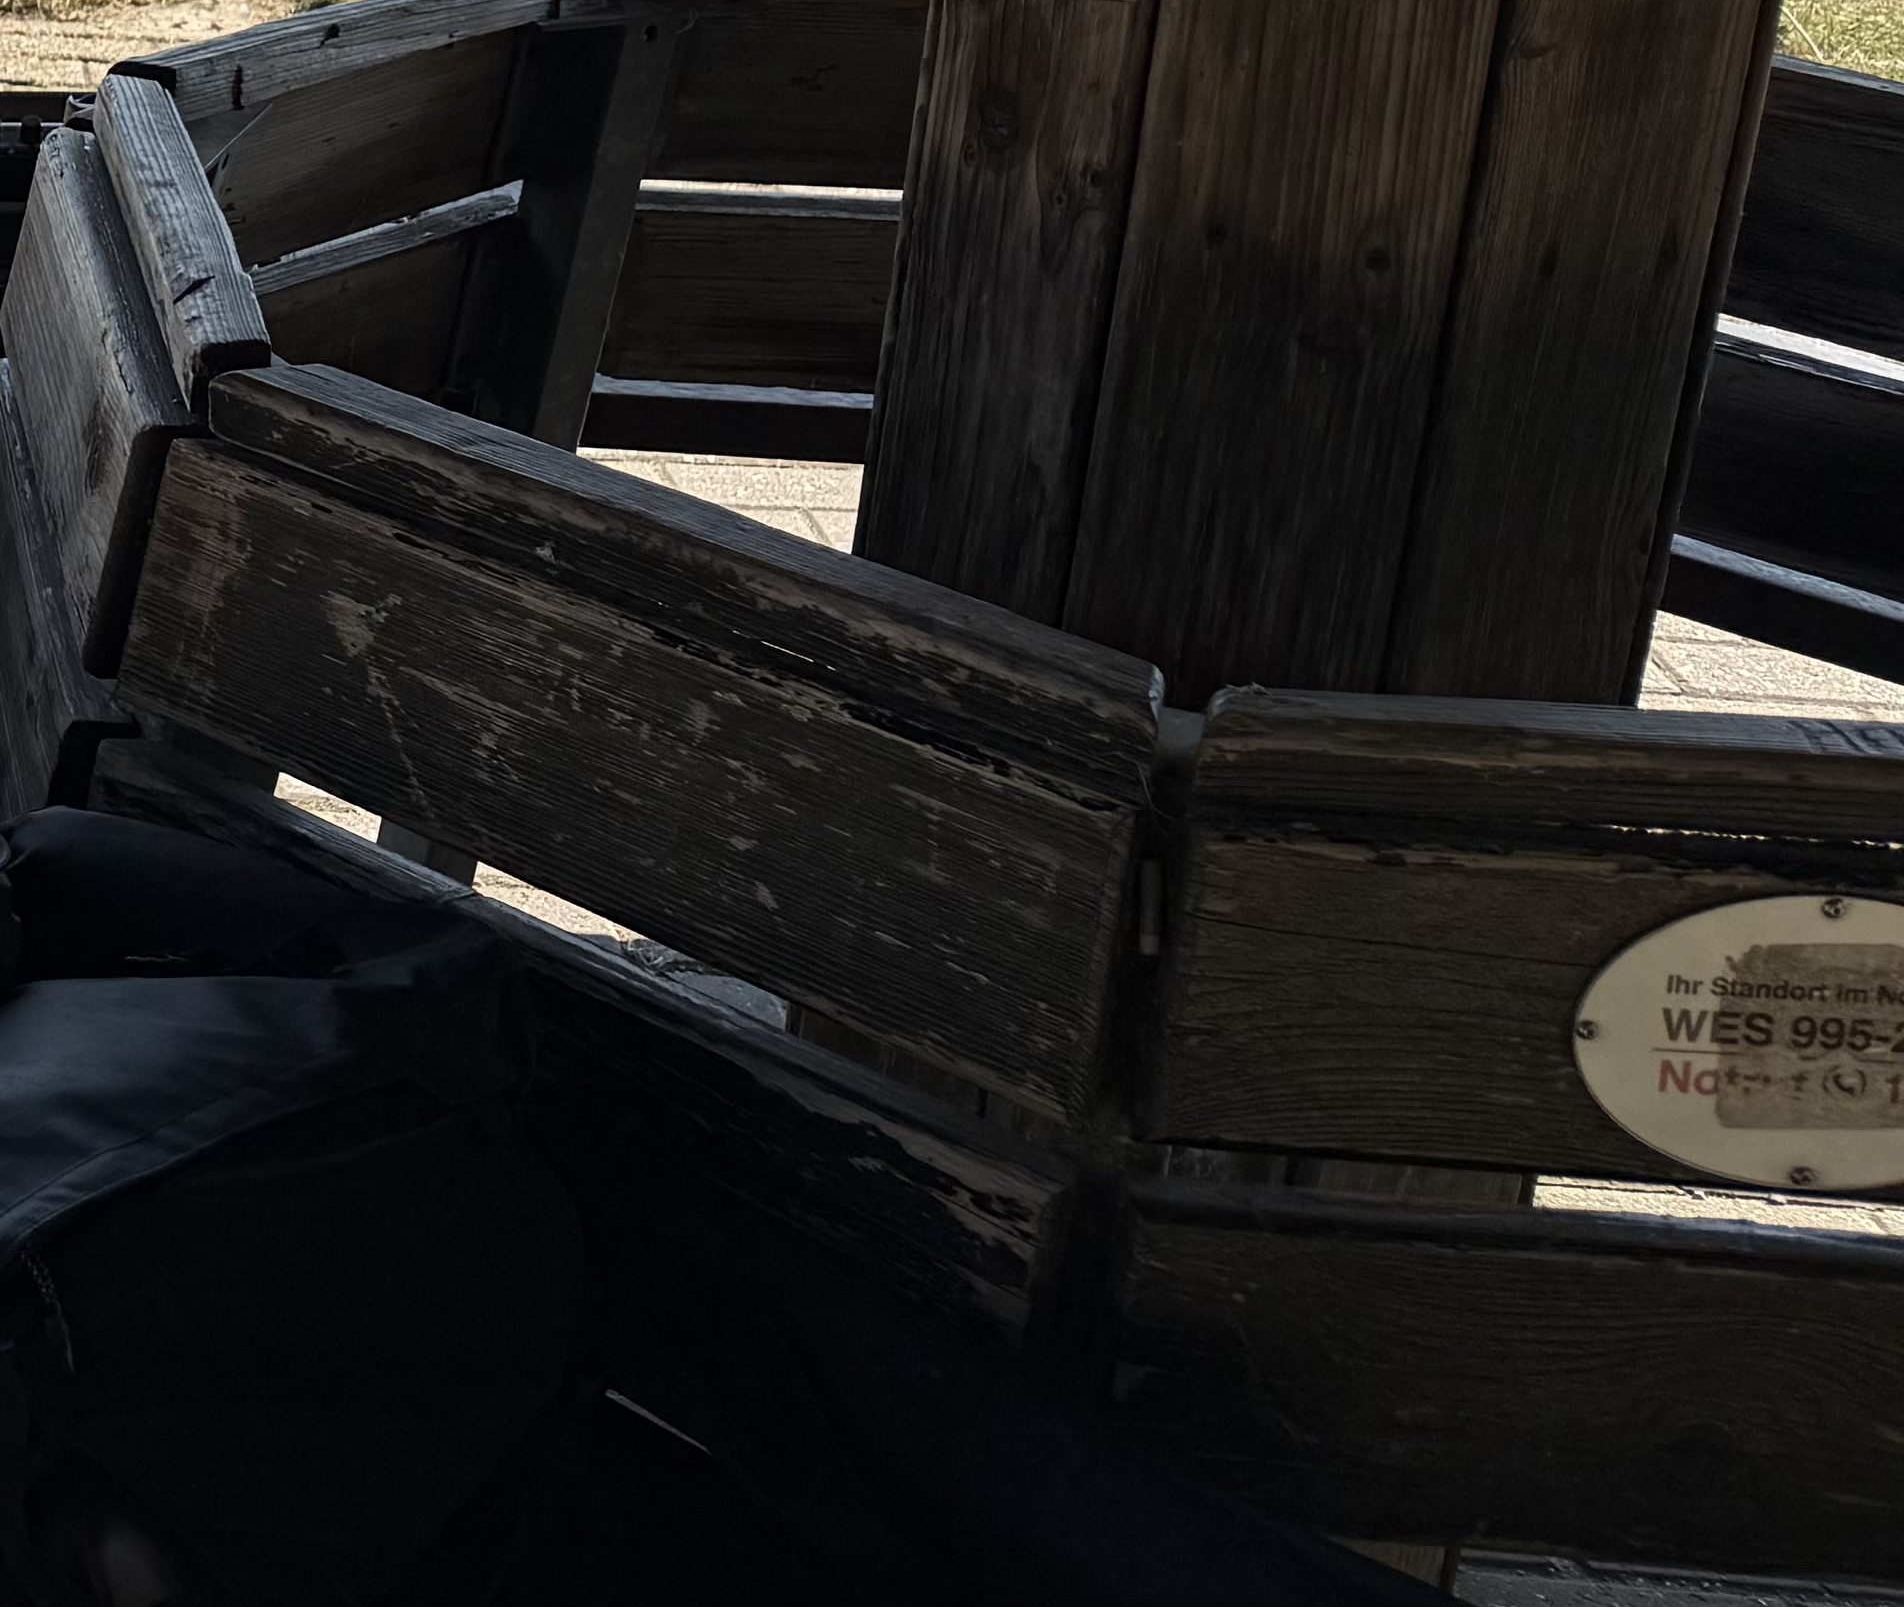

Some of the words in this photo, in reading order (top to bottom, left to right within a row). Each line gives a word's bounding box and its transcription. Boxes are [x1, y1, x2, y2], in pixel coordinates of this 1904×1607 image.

[1667, 974, 1703, 995] Ihr
[1710, 976, 1828, 1003] Standort
[1836, 984, 1868, 1004] im
[1662, 1007, 1774, 1046] WES
[1658, 1060, 1809, 1098] Not
